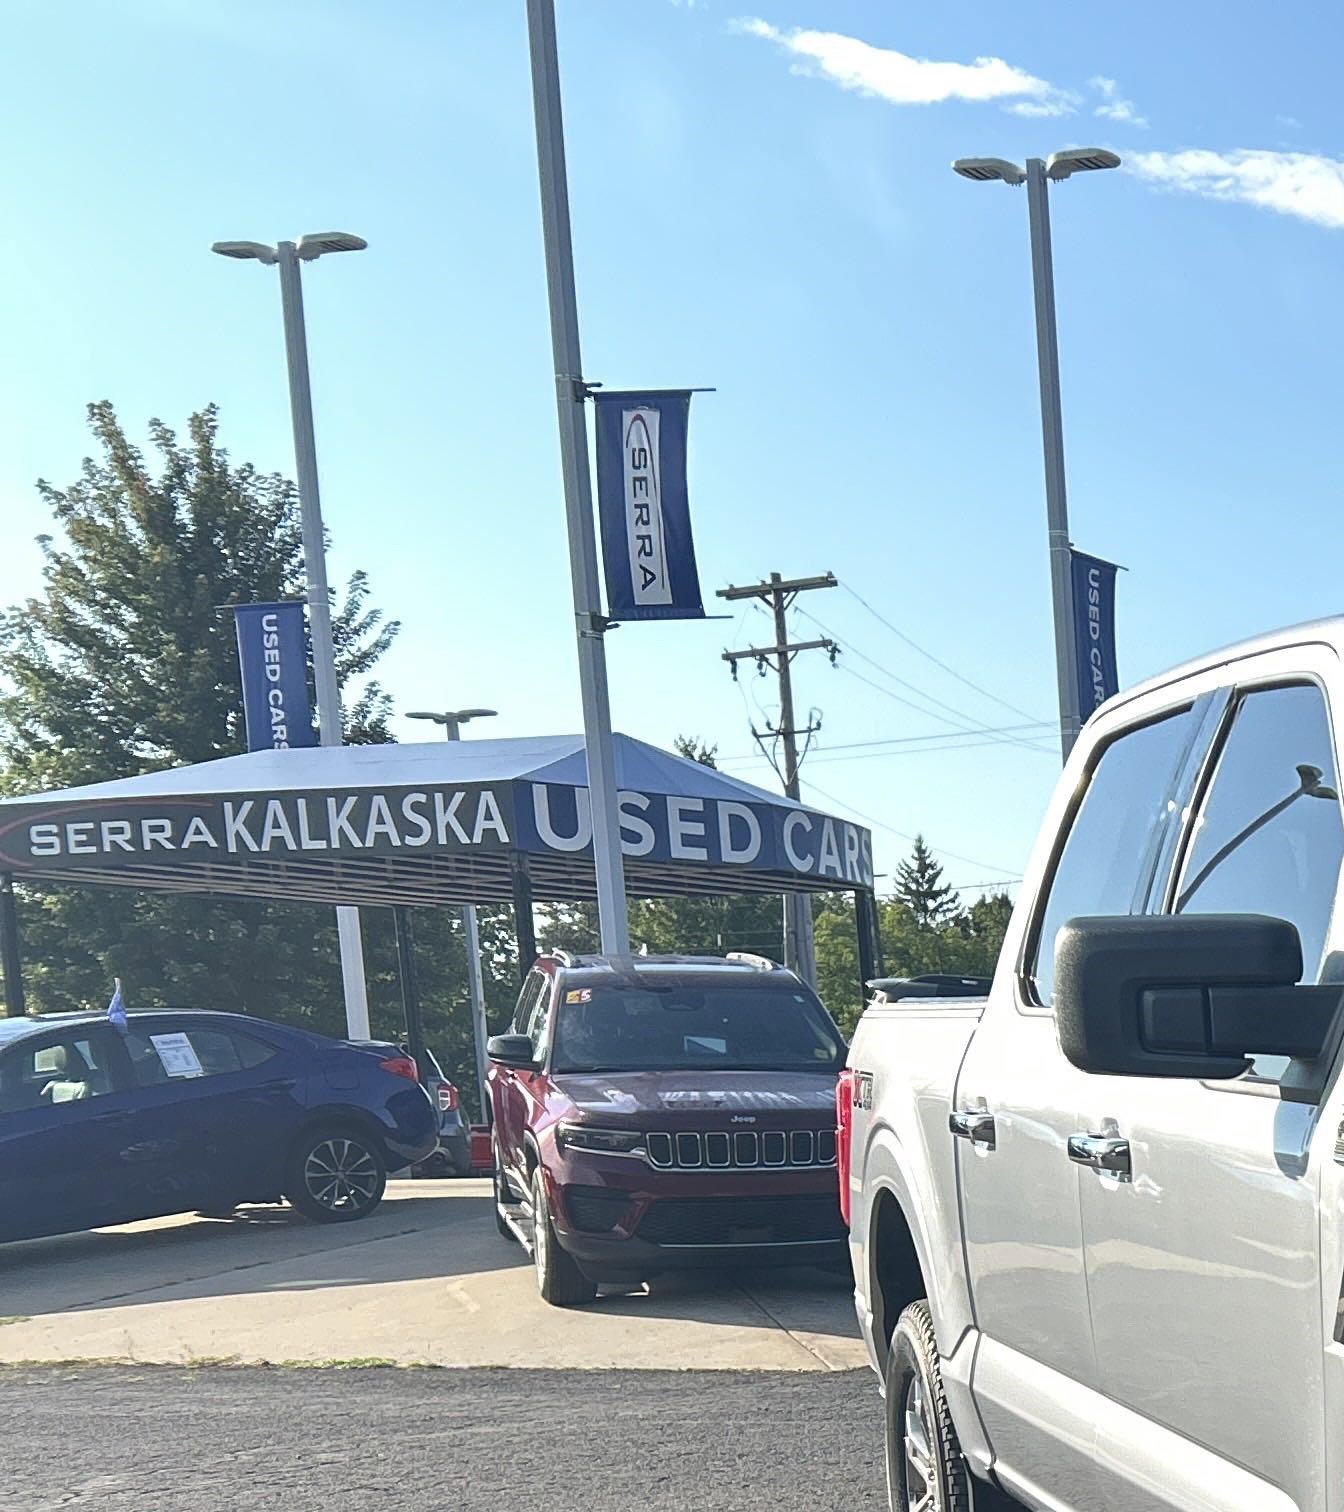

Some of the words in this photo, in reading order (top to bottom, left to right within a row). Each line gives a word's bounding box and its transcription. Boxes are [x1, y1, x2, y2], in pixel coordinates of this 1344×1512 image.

[631, 447, 657, 591] SERRA
[1088, 568, 1101, 641] USED
[262, 613, 281, 682] USED
[1090, 647, 1105, 708] CAR
[29, 816, 219, 856] SERRA
[223, 790, 511, 853] KALKASKA
[532, 783, 762, 864] USED
